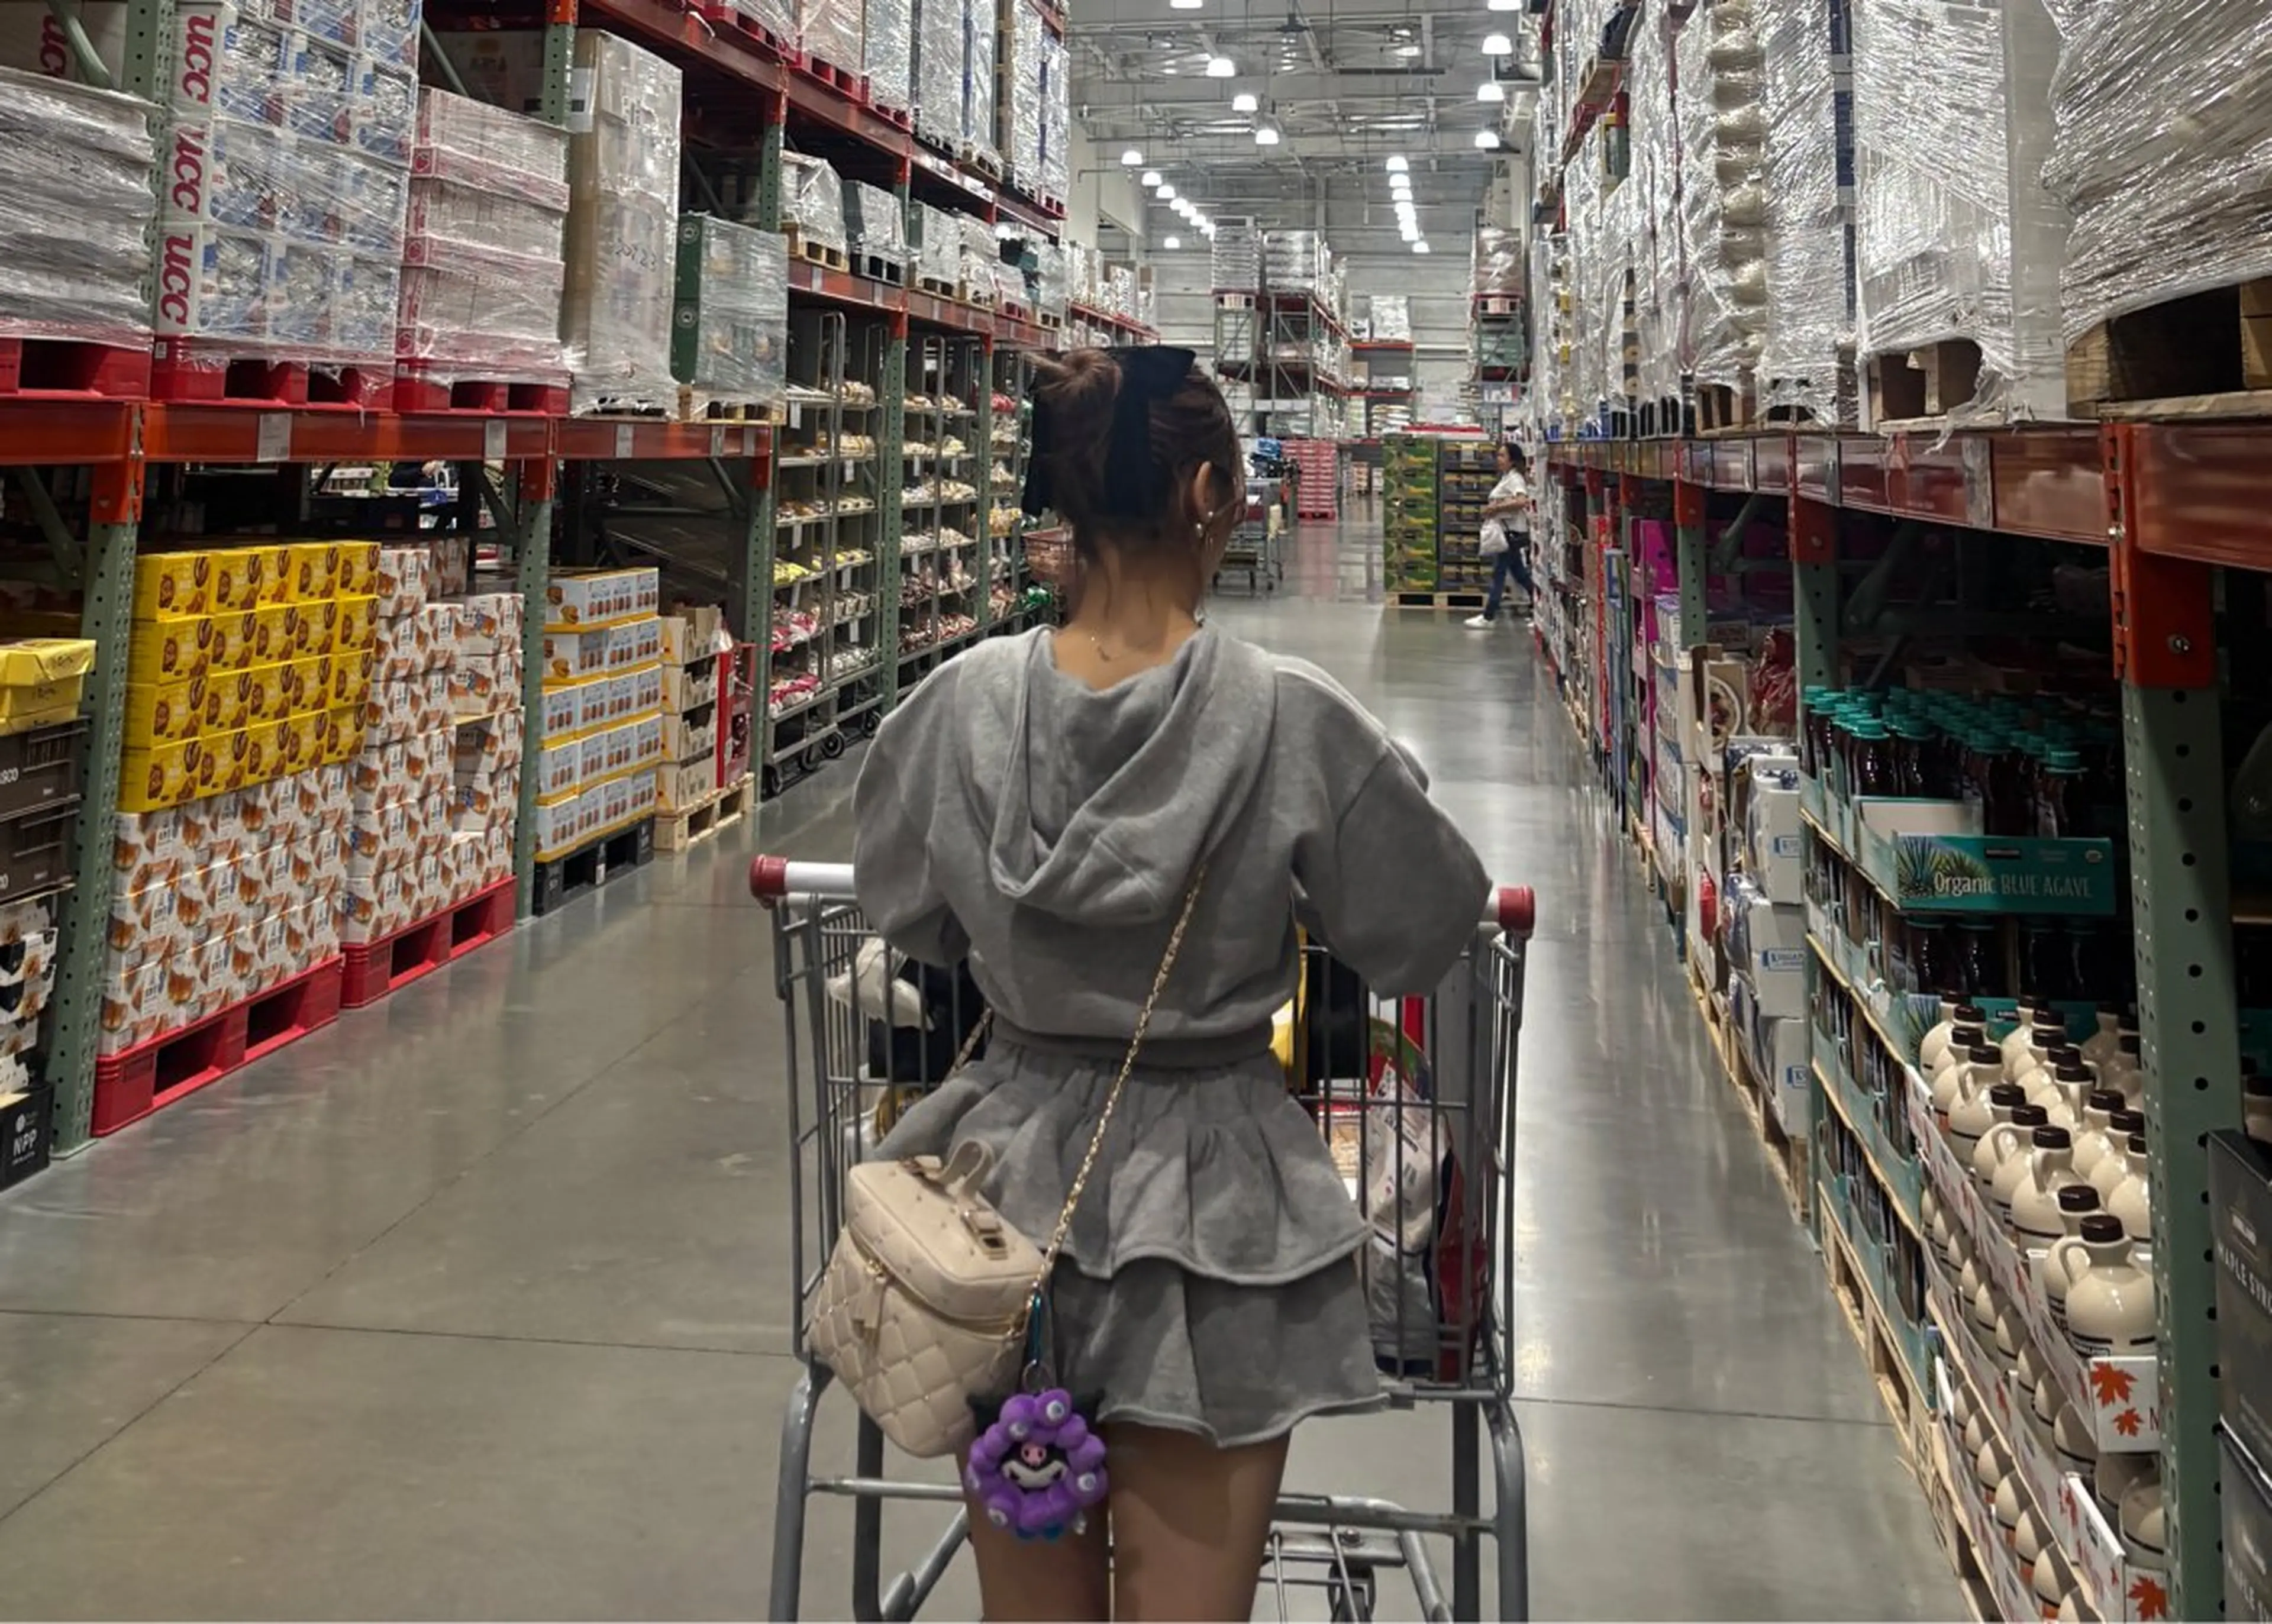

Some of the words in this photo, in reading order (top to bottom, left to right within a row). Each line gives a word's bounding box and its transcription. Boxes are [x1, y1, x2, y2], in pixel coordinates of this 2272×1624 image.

[40, 15, 68, 77] UC
[182, 15, 215, 104] UCC
[172, 123, 206, 214] UCC
[160, 234, 193, 325] UCC
[1934, 873, 1997, 897] Organic
[2000, 874, 2039, 896] BLUE
[2042, 877, 2094, 899] AGAVE
[2218, 1236, 2248, 1287] MAPLE
